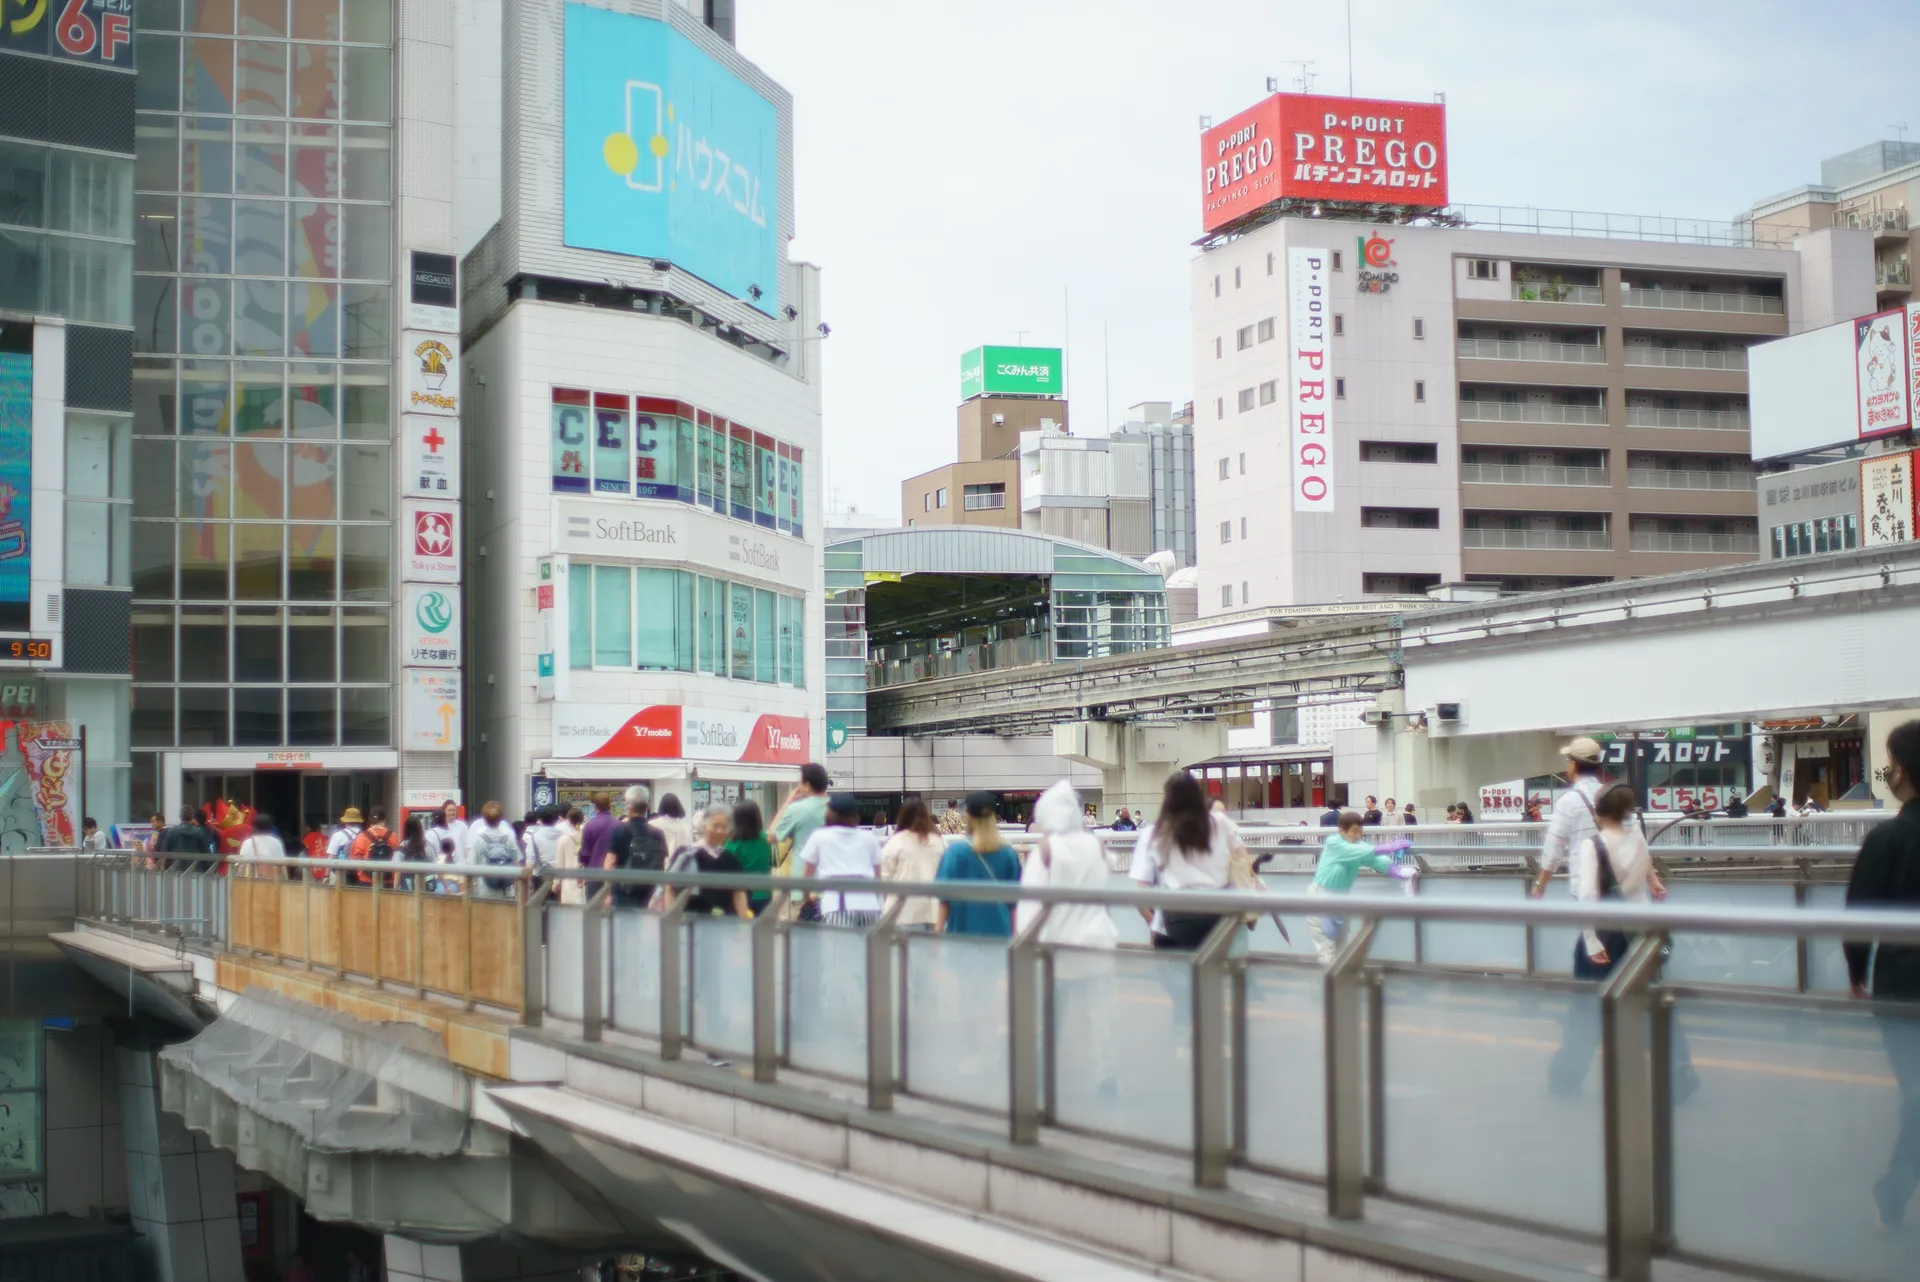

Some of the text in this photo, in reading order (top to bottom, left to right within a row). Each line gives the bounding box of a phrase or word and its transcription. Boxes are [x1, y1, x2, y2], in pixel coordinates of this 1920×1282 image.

[55, 0, 131, 61] 6F
[1294, 133, 1437, 170] PREGO
[675, 121, 766, 229] ハウスコム
[1206, 137, 1273, 194] PREGO
[1294, 164, 1438, 189] パチンコ・スロット
[1207, 172, 1276, 212] PACHINKO SLOT
[415, 273, 451, 286] MEGALOS
[1357, 271, 1399, 283] KOMURO
[1859, 326, 1869, 336] 1F
[997, 364, 1049, 377] こくみん共済
[1871, 392, 1896, 405] カラオケ
[559, 408, 657, 452] CEC
[1298, 347, 1328, 502] PREGO
[765, 454, 798, 496] CEC
[1891, 463, 1903, 505] 立川
[600, 481, 658, 495] SINCE 1967
[596, 518, 677, 544] SoftBank
[411, 561, 457, 571] Tokyu Store
[742, 538, 780, 572] SoftBank
[411, 648, 457, 660] りそな銀行
[0, 685, 36, 703] PEI
[572, 725, 611, 738] SoftBank
[700, 721, 738, 748] SoftBank
[1651, 786, 1719, 810] こちら
